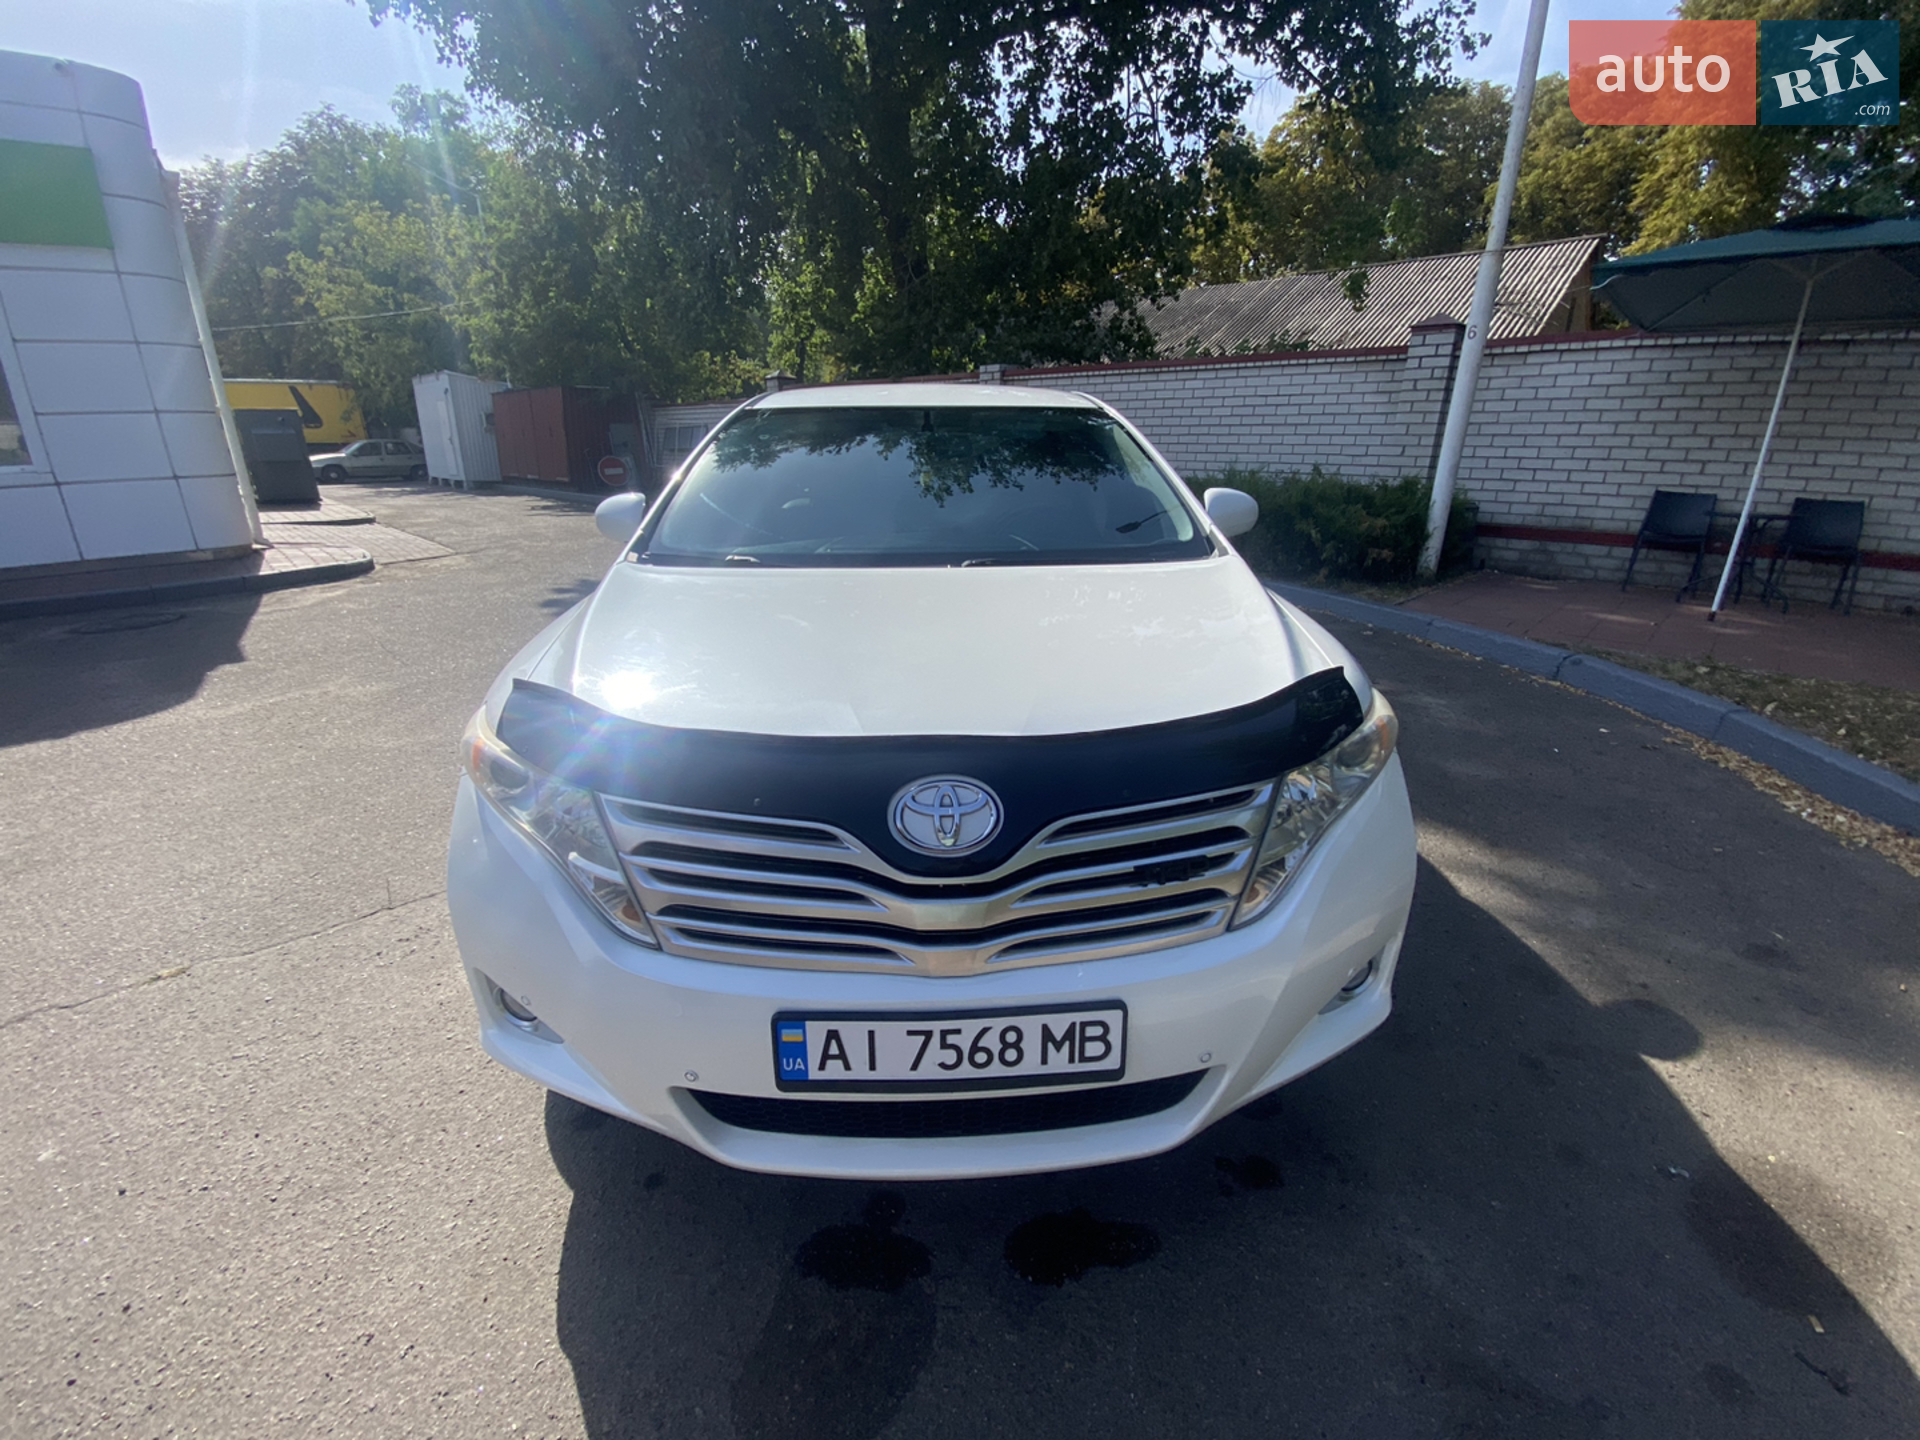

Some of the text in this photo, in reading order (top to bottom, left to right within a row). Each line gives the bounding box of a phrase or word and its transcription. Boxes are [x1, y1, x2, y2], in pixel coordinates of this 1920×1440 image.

[1467, 324, 1478, 340] 6
[817, 1020, 1113, 1072] AI 7568 MB
[782, 1057, 806, 1071] UA
